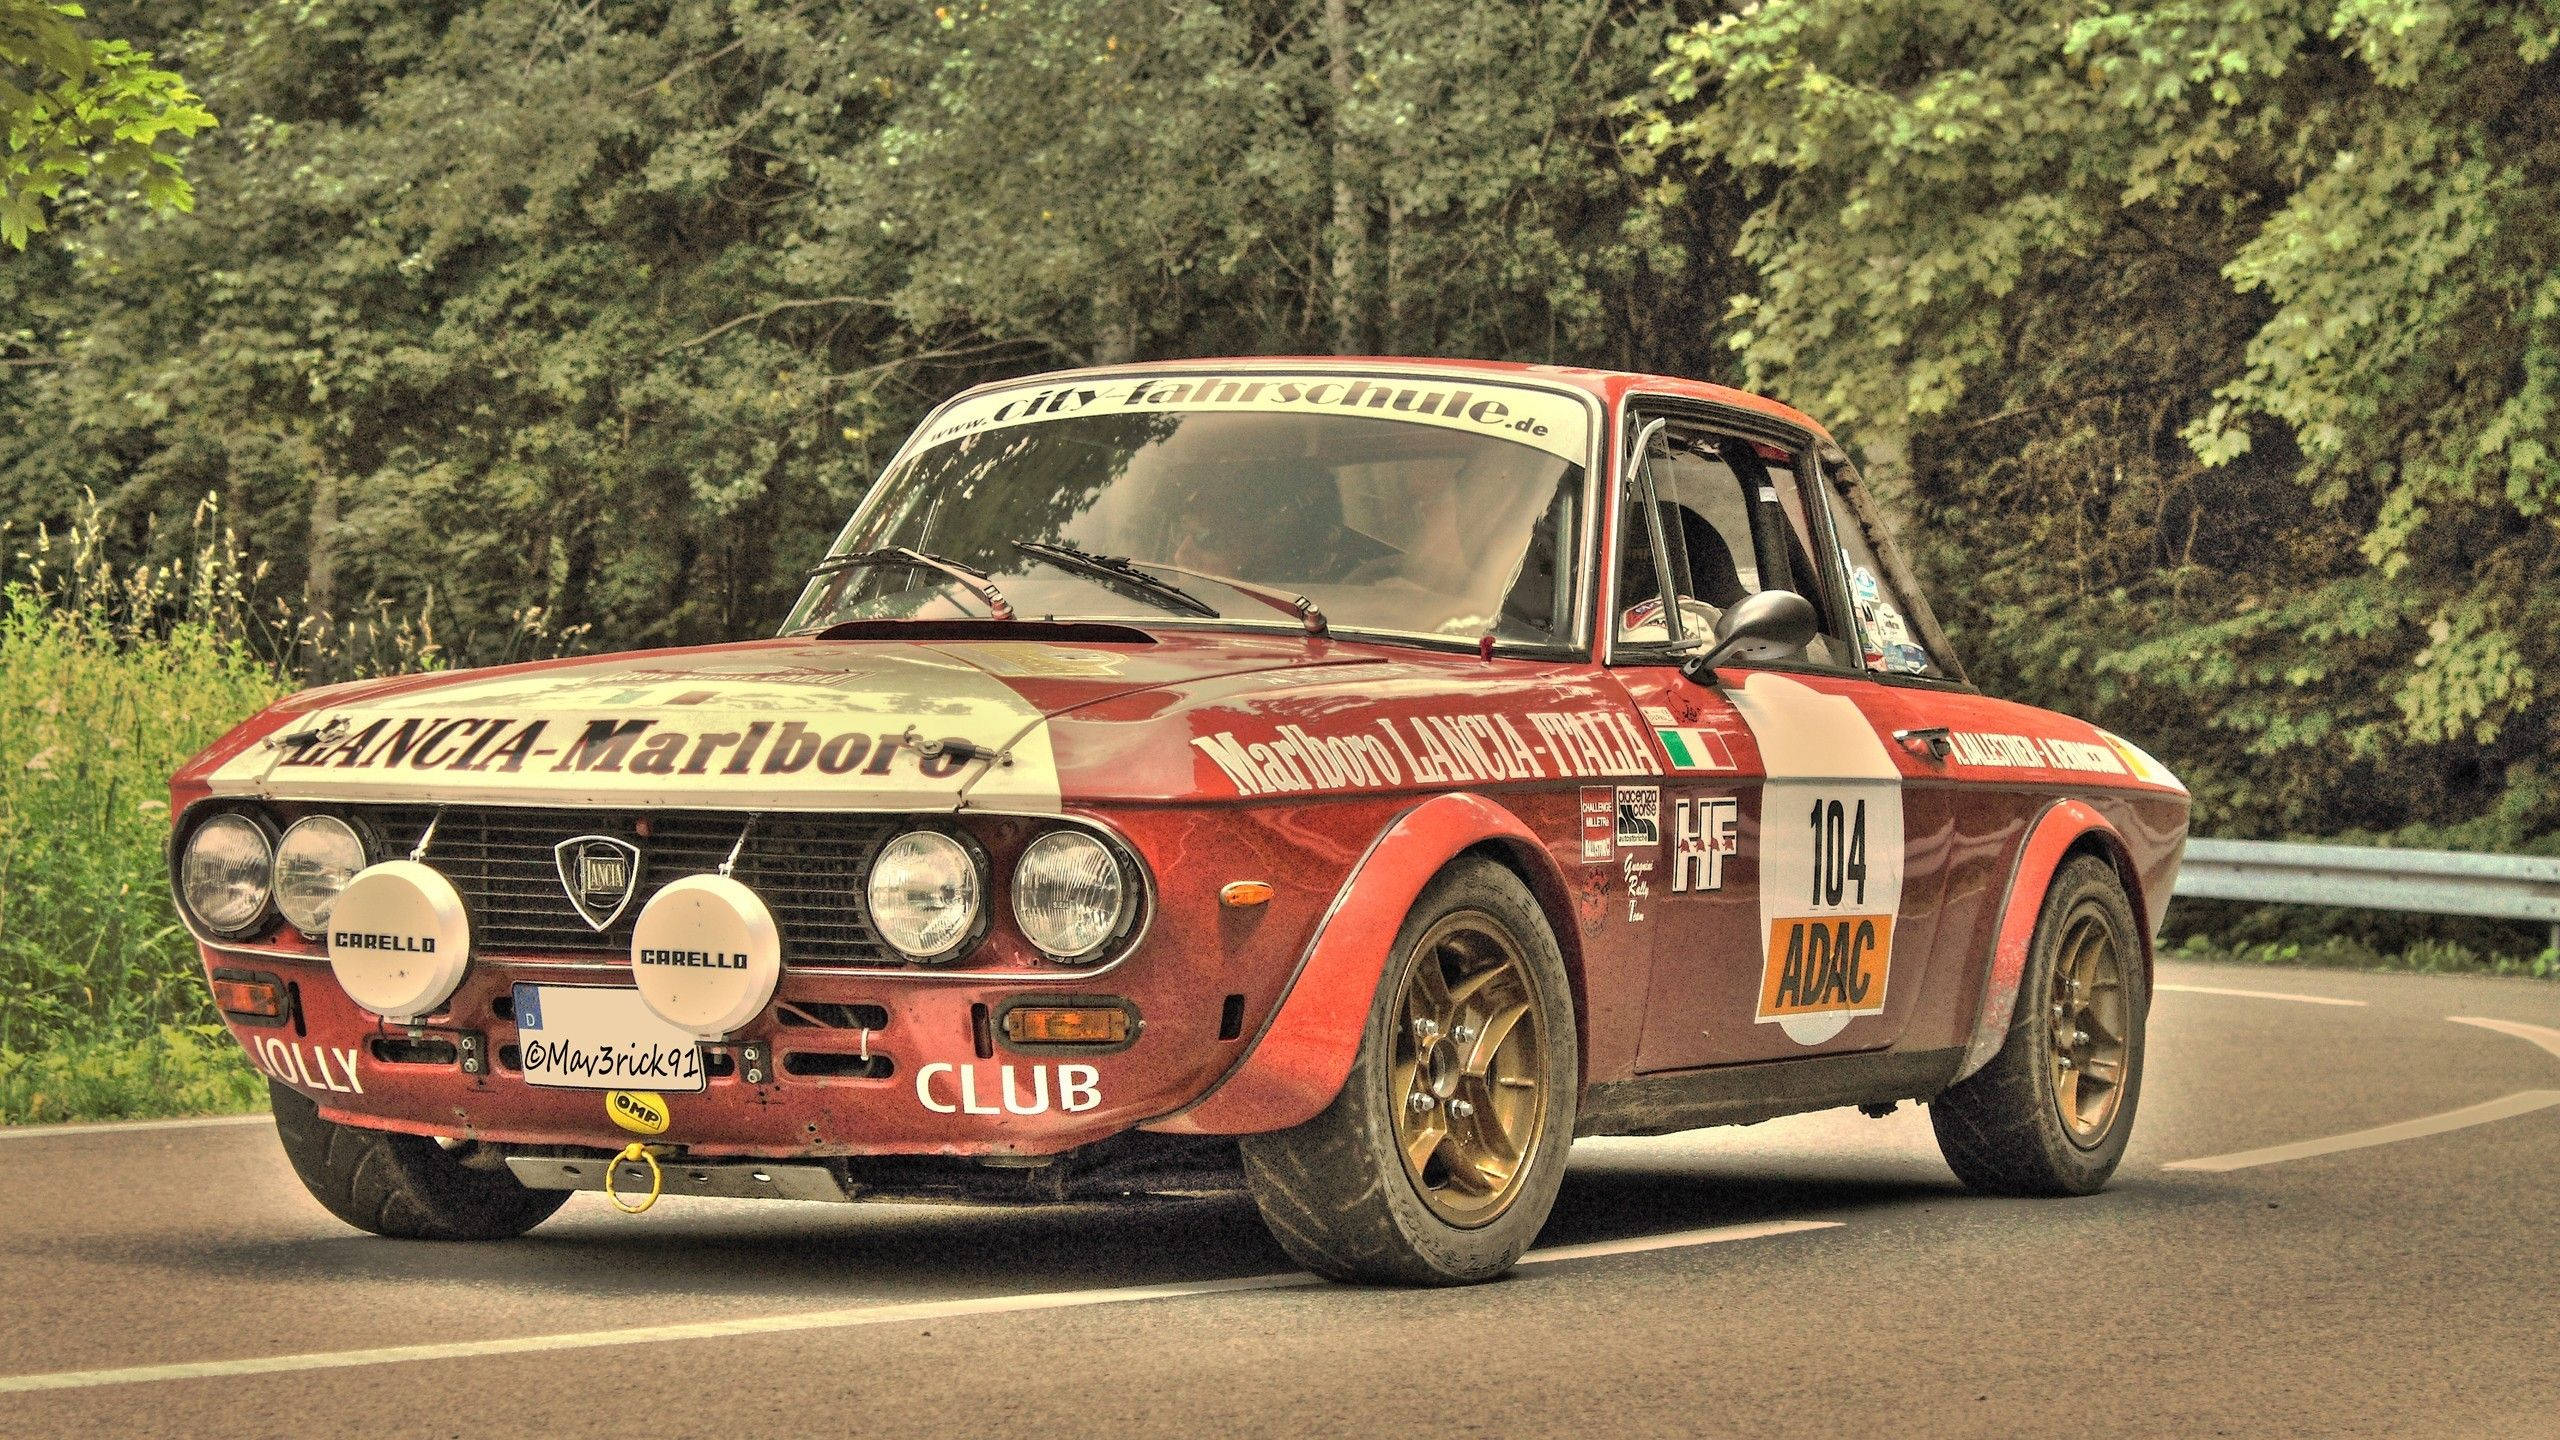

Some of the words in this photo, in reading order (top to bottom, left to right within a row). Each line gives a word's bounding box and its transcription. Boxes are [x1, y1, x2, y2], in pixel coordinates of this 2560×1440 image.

[1190, 723, 1401, 796] Marlboro
[1376, 712, 1664, 785] LANCIA-ITALIA
[1583, 802, 1612, 813] CHALLENGE
[1618, 790, 1658, 804] piacenza
[1633, 803, 1657, 817] corse
[1672, 797, 1737, 892] HF
[1810, 798, 1866, 906] 104
[587, 860, 624, 891] LANCIA
[1628, 874, 1650, 900] Rally
[1628, 899, 1645, 922] Team
[335, 932, 436, 953] CARELLO
[641, 949, 747, 969] CARELLO
[1775, 919, 1875, 1009] ADAC
[525, 1013, 535, 1027] D
[253, 1034, 364, 1094] JOLLY
[916, 1062, 1102, 1116] CLUB
[616, 1095, 661, 1123] OMP
